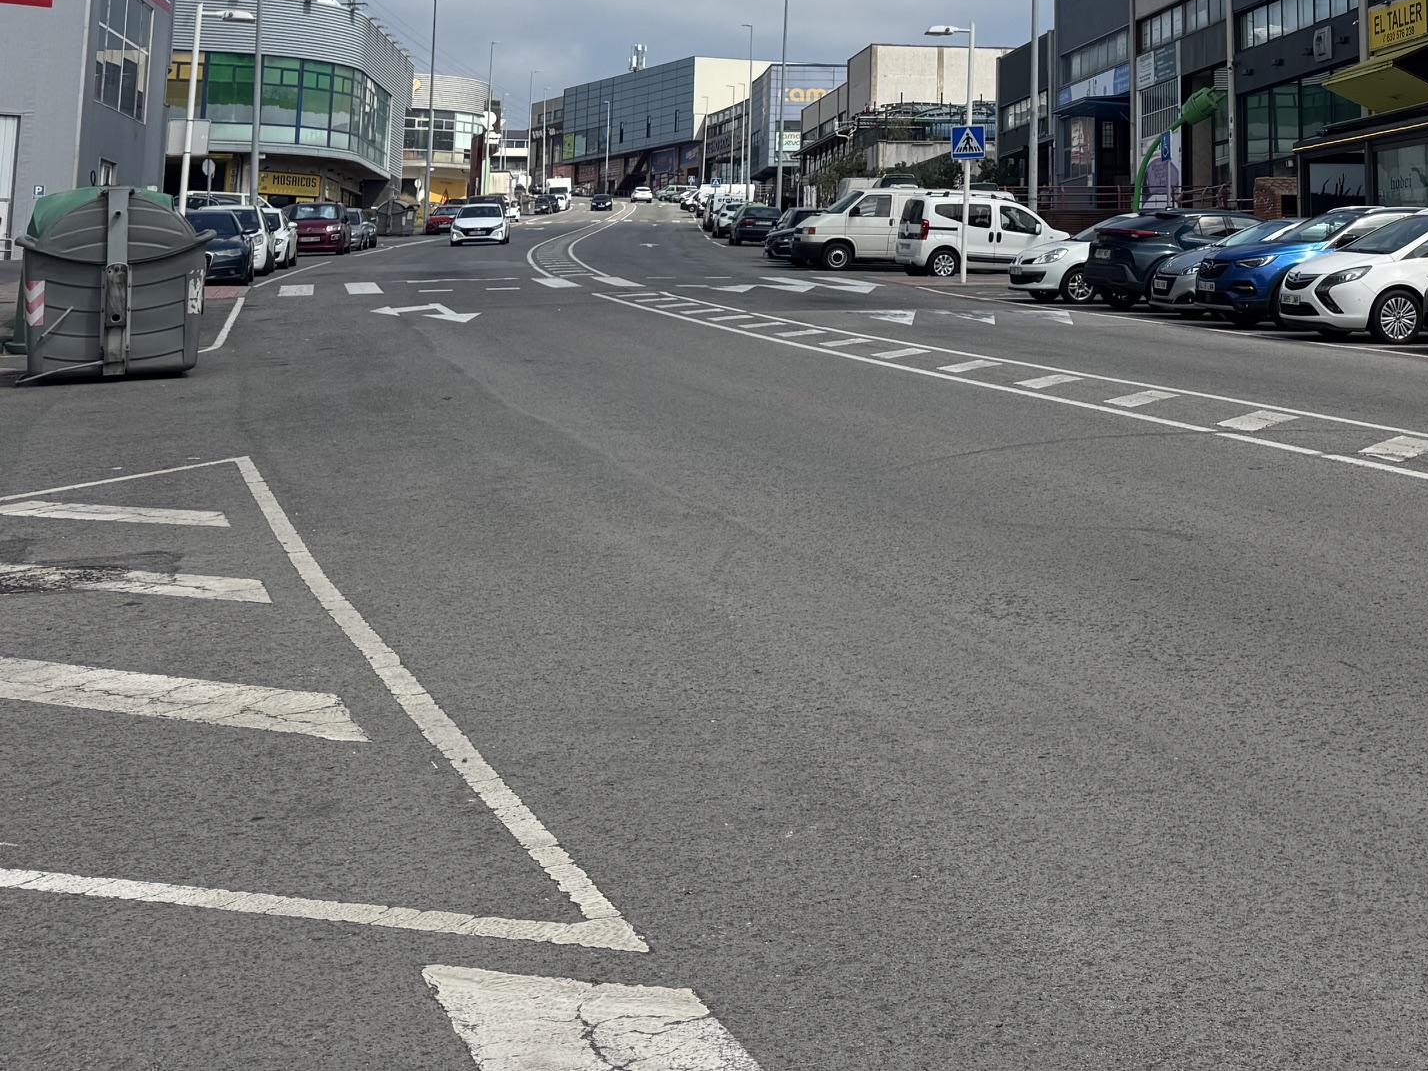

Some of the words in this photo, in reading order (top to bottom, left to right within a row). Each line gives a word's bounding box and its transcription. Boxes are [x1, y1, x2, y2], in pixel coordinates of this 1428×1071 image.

[1374, 15, 1386, 35] EL
[1387, 2, 1423, 31] TALLER
[272, 174, 317, 188] MOSAICOS
